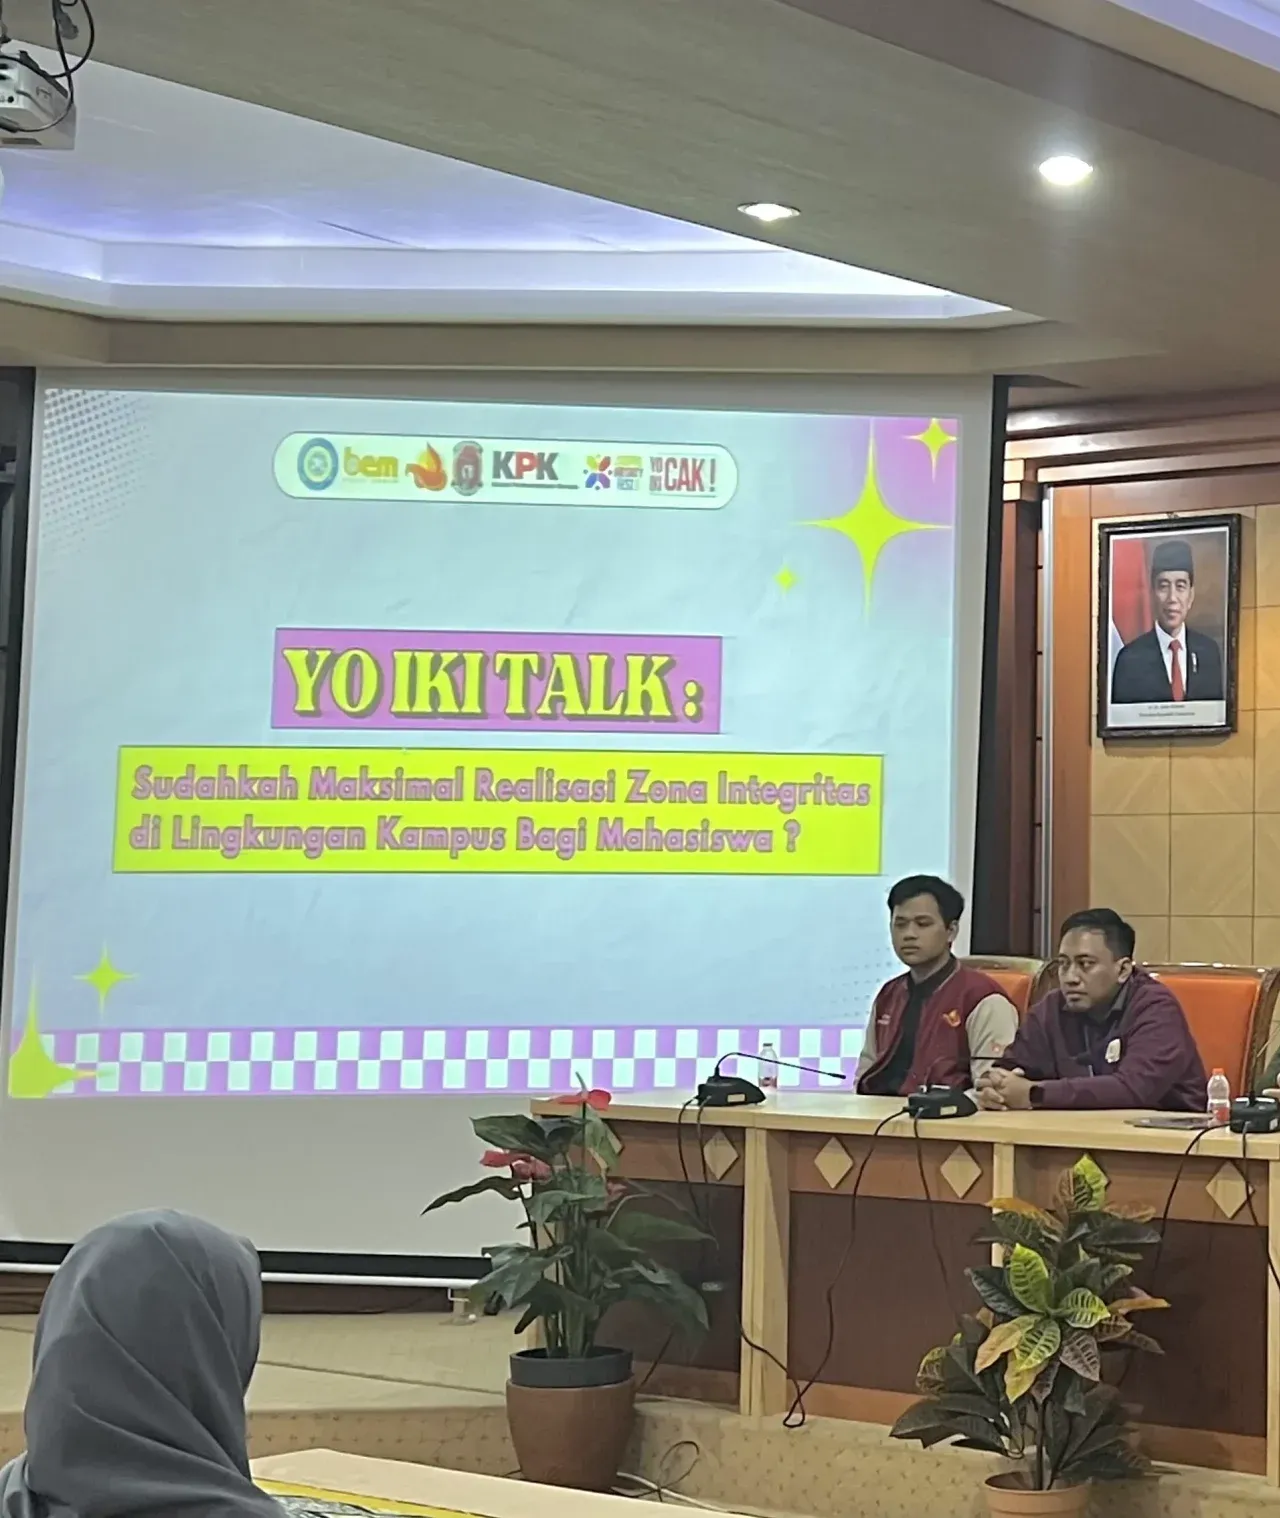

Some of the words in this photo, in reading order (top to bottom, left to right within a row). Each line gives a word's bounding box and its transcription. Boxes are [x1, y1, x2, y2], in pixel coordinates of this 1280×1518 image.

[344, 446, 398, 477] bem
[492, 450, 559, 481] KPK
[282, 647, 383, 718] YO
[390, 649, 487, 720] IKI
[132, 764, 298, 801] Sudahkah
[308, 765, 465, 802] Maksimal
[474, 766, 616, 803] Realisasi
[625, 768, 708, 804] Zona
[718, 770, 871, 814] Integritas
[129, 814, 161, 850] di
[171, 814, 366, 859] Lingkungan
[376, 815, 506, 860] Kampus
[515, 816, 588, 861] Bagi
[596, 816, 773, 853] Mahasiswa
